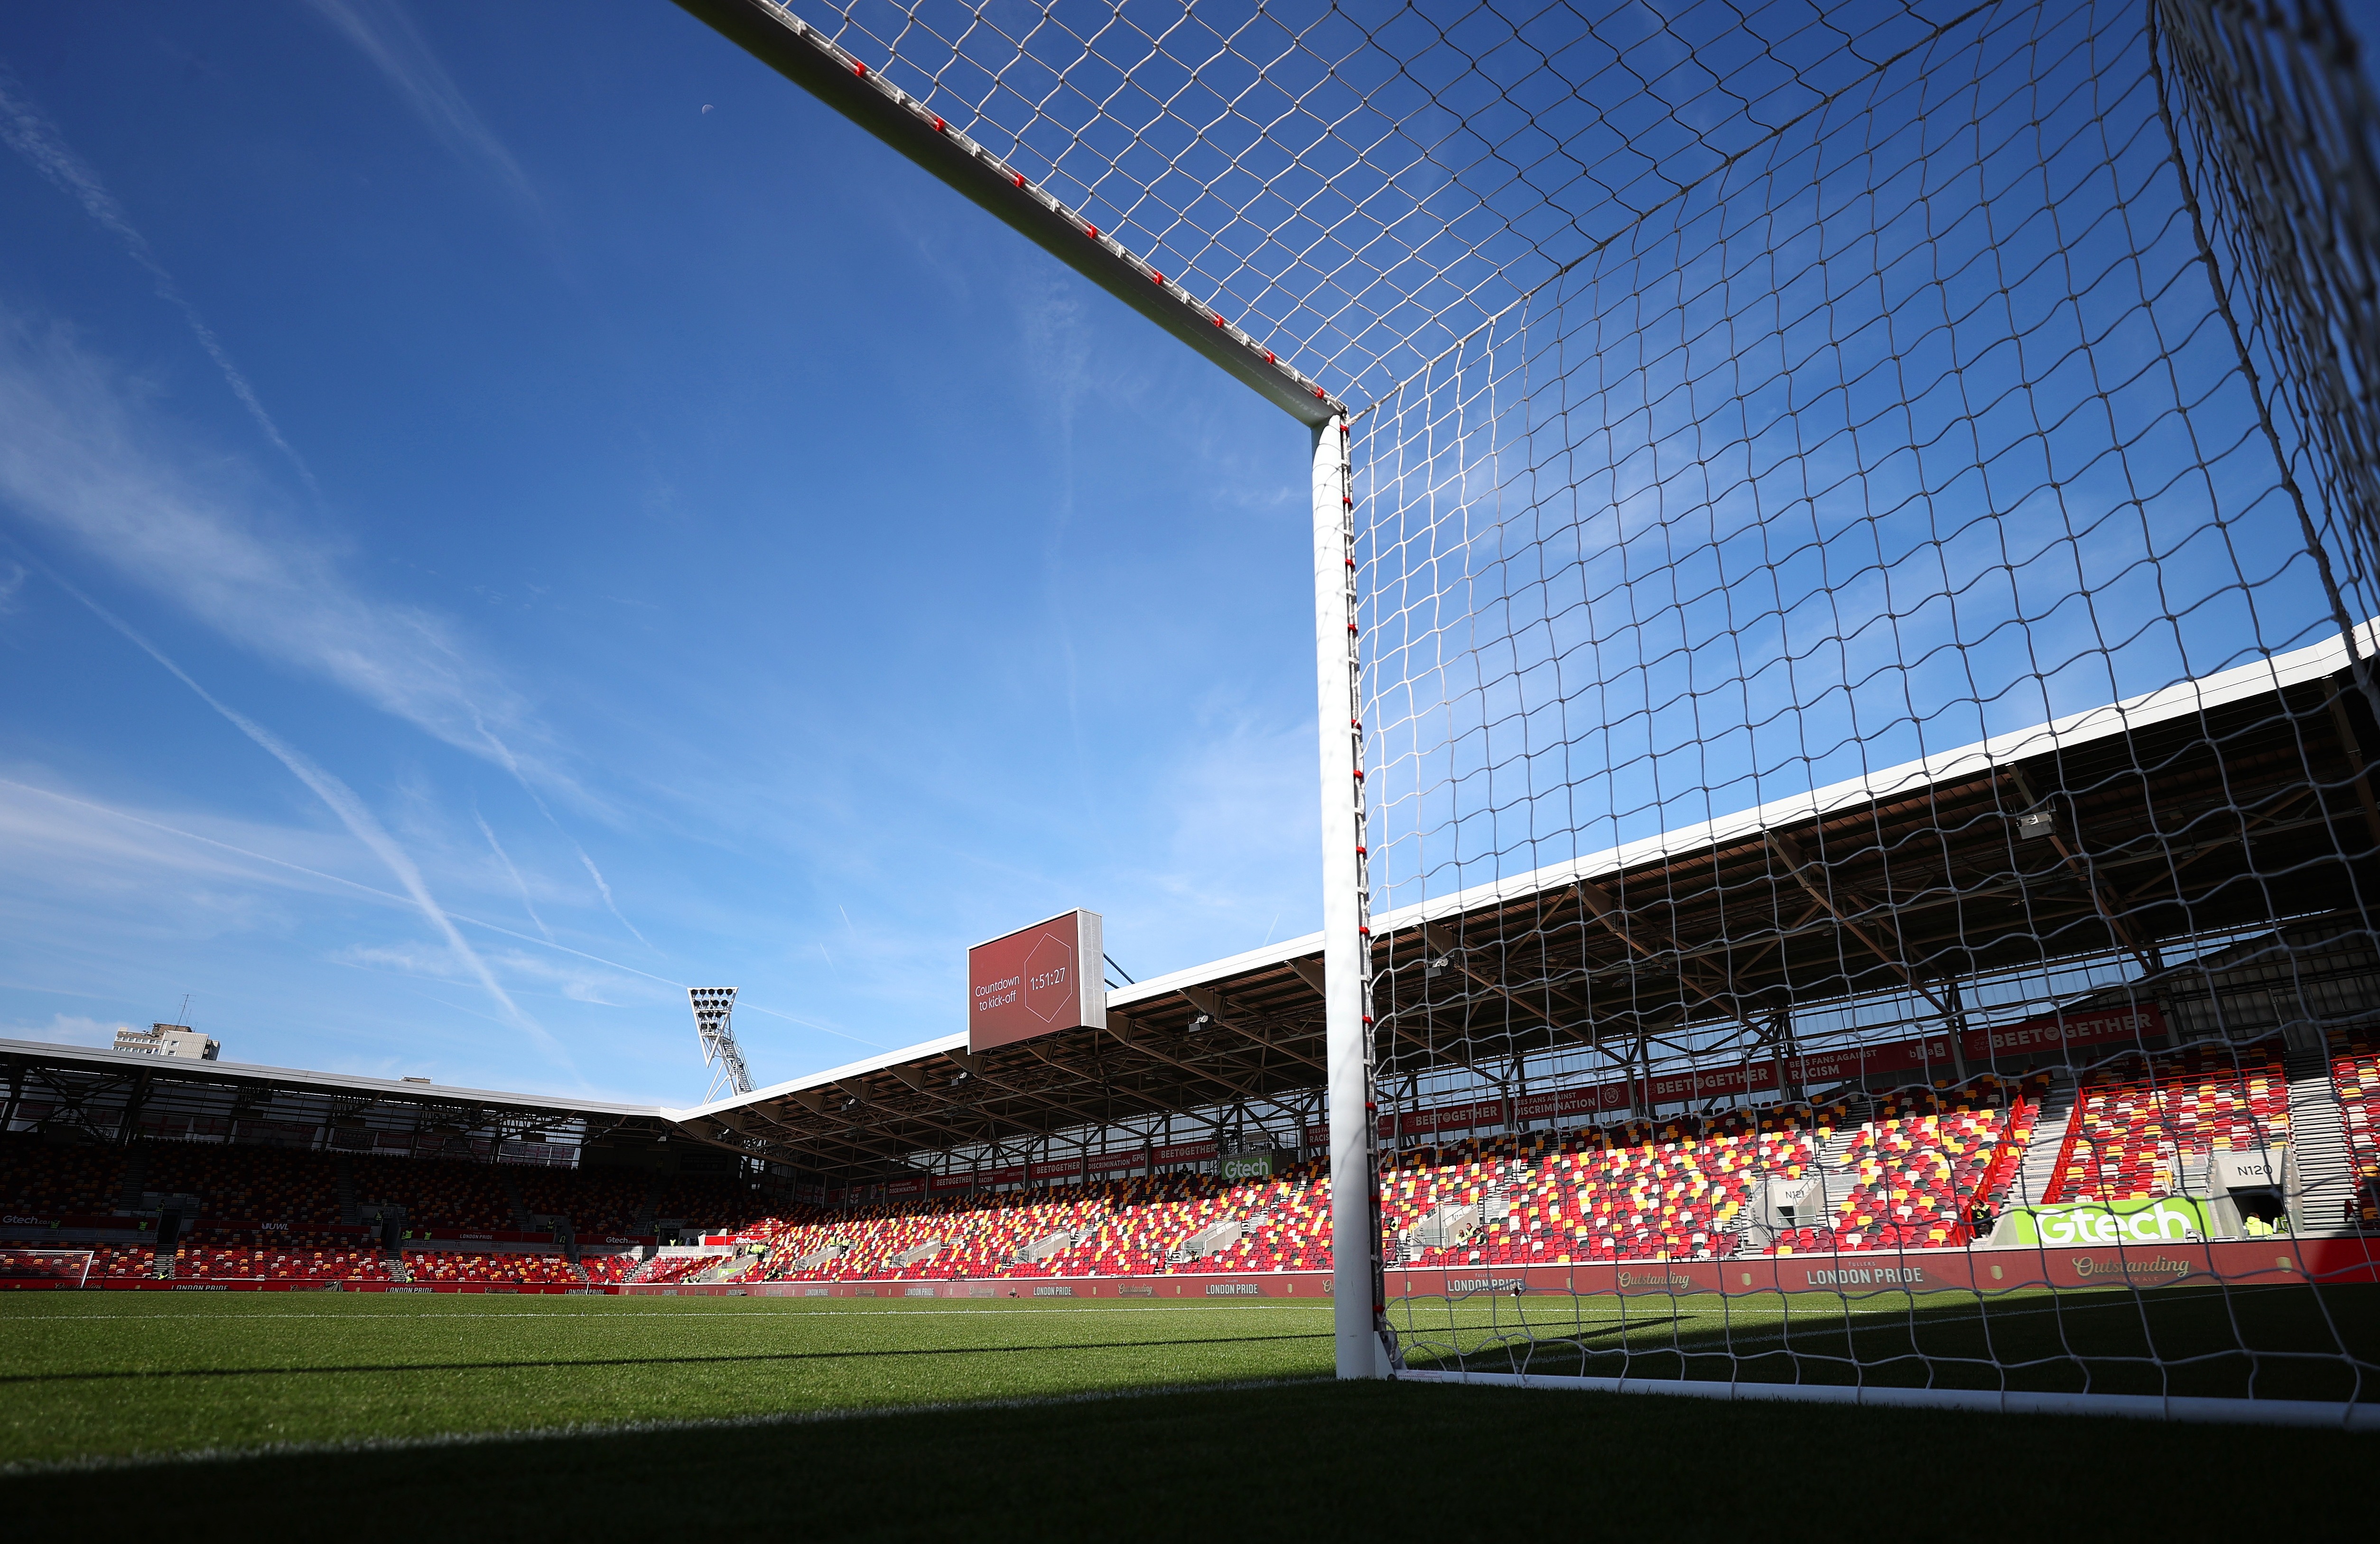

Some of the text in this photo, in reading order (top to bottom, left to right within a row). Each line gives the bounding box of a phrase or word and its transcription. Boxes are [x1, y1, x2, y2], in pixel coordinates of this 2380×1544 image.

[1030, 967, 1066, 990] 1:51:27
[975, 975, 1020, 997] Countdown
[979, 990, 1017, 1011] to kick-off
[1790, 1050, 1877, 1068] BEES FANS AGAINST
[1791, 1064, 1841, 1080] RACISM
[1547, 1092, 1577, 1101] AGAINST
[1514, 1098, 1596, 1116] DISCRIMINATION
[1310, 1134, 1329, 1143] RACIS
[1088, 1159, 1130, 1170] DISCRIMINATION
[1132, 1153, 1145, 1162] GPG
[1225, 1157, 1269, 1179] Gtech
[2237, 1165, 2272, 1175] N120
[889, 1185, 917, 1193] DISCRIMINATION
[2033, 1202, 2192, 1244] Gtech
[2072, 1255, 2190, 1277] Outstanding
[1618, 1271, 1690, 1289] Outstanding
[1807, 1267, 1923, 1285] LONDON PRIDE
[905, 1288, 934, 1296] LONDON PRIDE
[1033, 1286, 1071, 1296] LONDON PRIDE
[1118, 1283, 1153, 1295] Outstanding
[1206, 1284, 1258, 1294] LONDON PRIDE
[1448, 1279, 1491, 1292] LONDON
